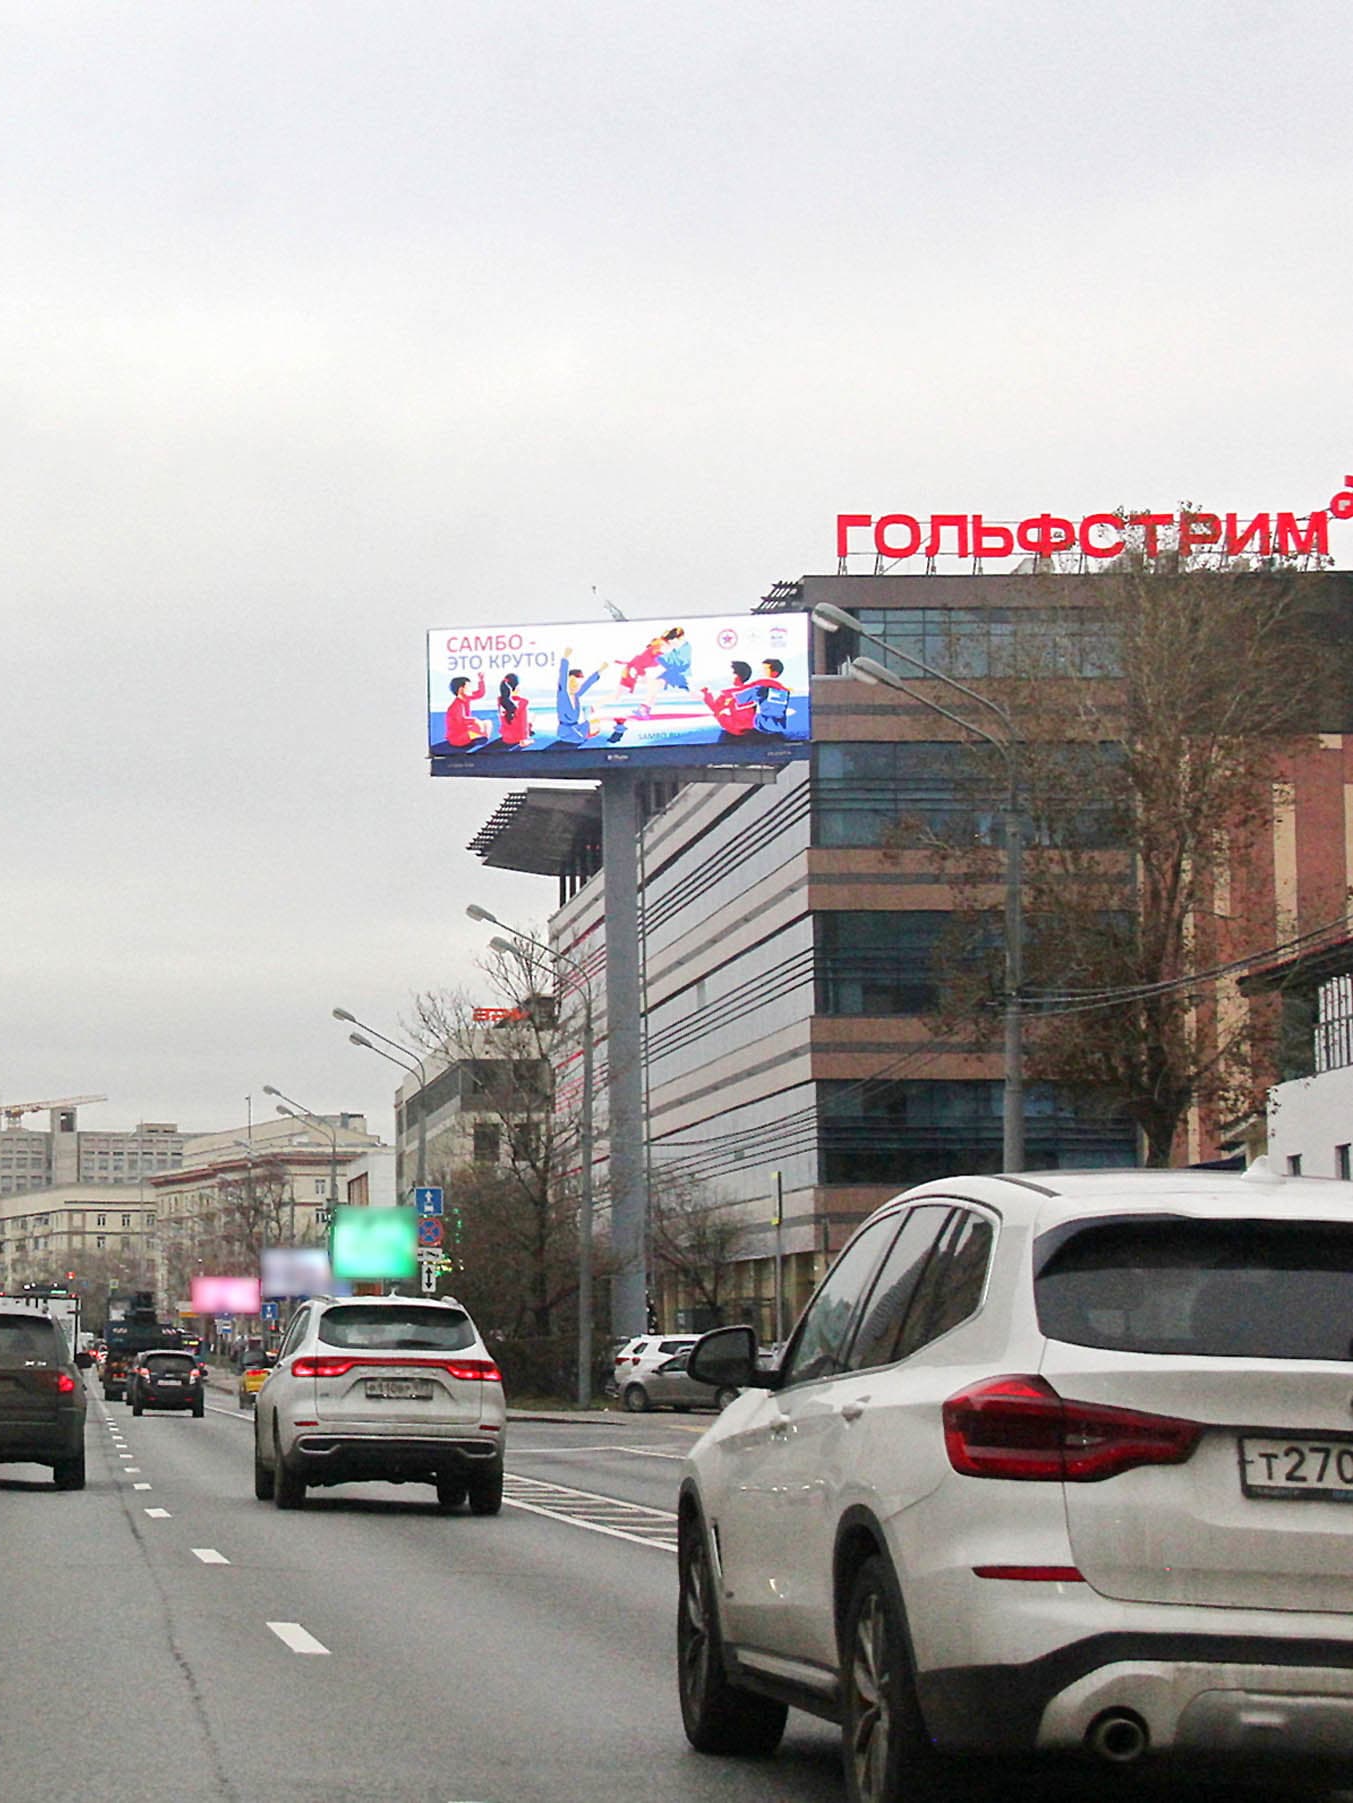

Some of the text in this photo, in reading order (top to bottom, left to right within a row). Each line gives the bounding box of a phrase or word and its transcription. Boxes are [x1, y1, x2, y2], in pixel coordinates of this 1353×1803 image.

[836, 512, 1329, 559] ГОЛЬФСТРИМ
[446, 633, 523, 653] САМБО
[447, 651, 555, 671] ЭТО КРУТО!
